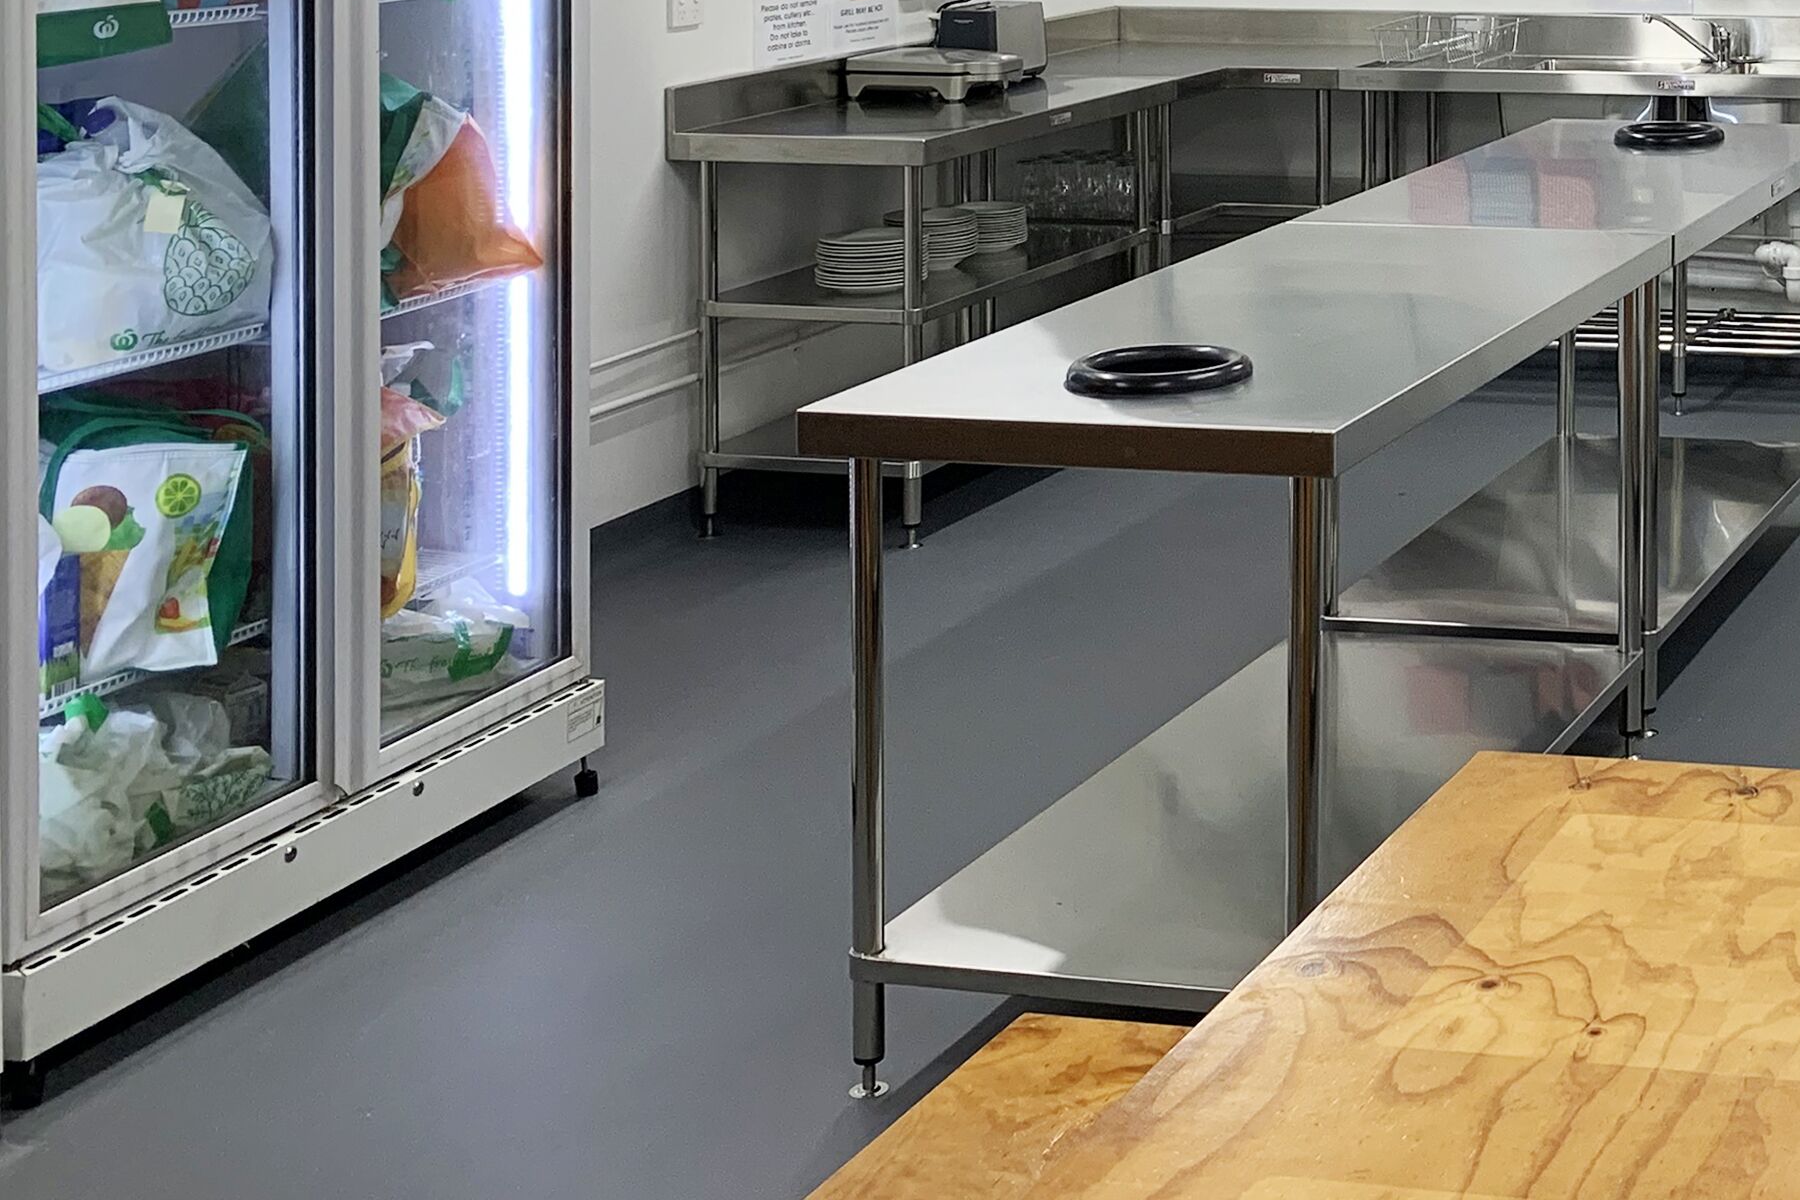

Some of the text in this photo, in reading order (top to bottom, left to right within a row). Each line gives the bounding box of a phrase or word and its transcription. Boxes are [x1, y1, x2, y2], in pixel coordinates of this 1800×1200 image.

[790, 1, 799, 9] not
[800, 0, 818, 8] remove
[773, 23, 786, 31] from
[769, 29, 809, 41] Do not take to
[767, 43, 787, 52] cabins
